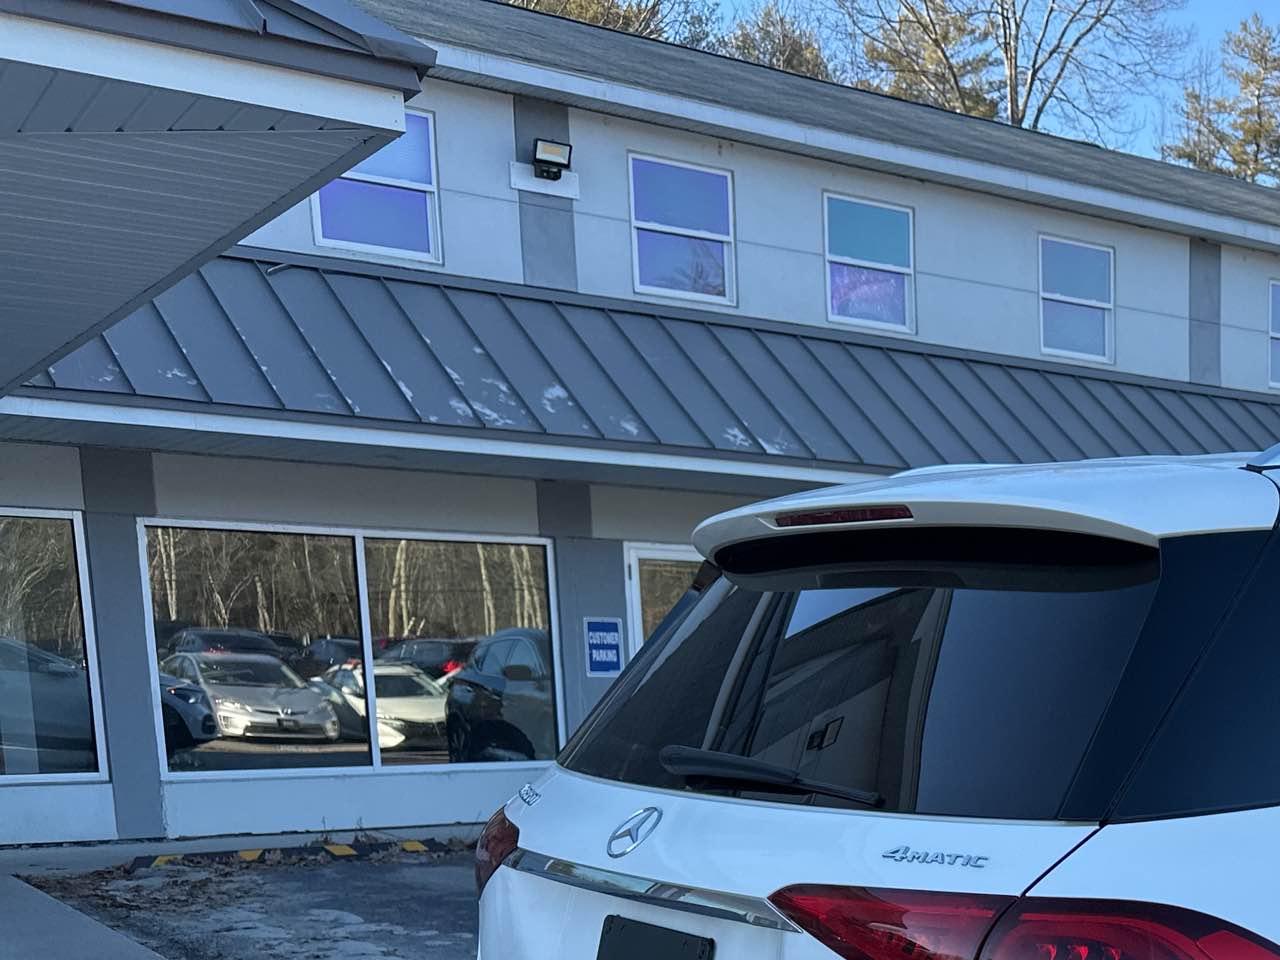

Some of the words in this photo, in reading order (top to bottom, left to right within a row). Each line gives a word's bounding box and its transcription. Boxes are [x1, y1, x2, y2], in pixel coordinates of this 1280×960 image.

[589, 631, 619, 645] CUSTOMER
[591, 649, 618, 662] PARKING
[882, 845, 990, 868] 4MATIC
